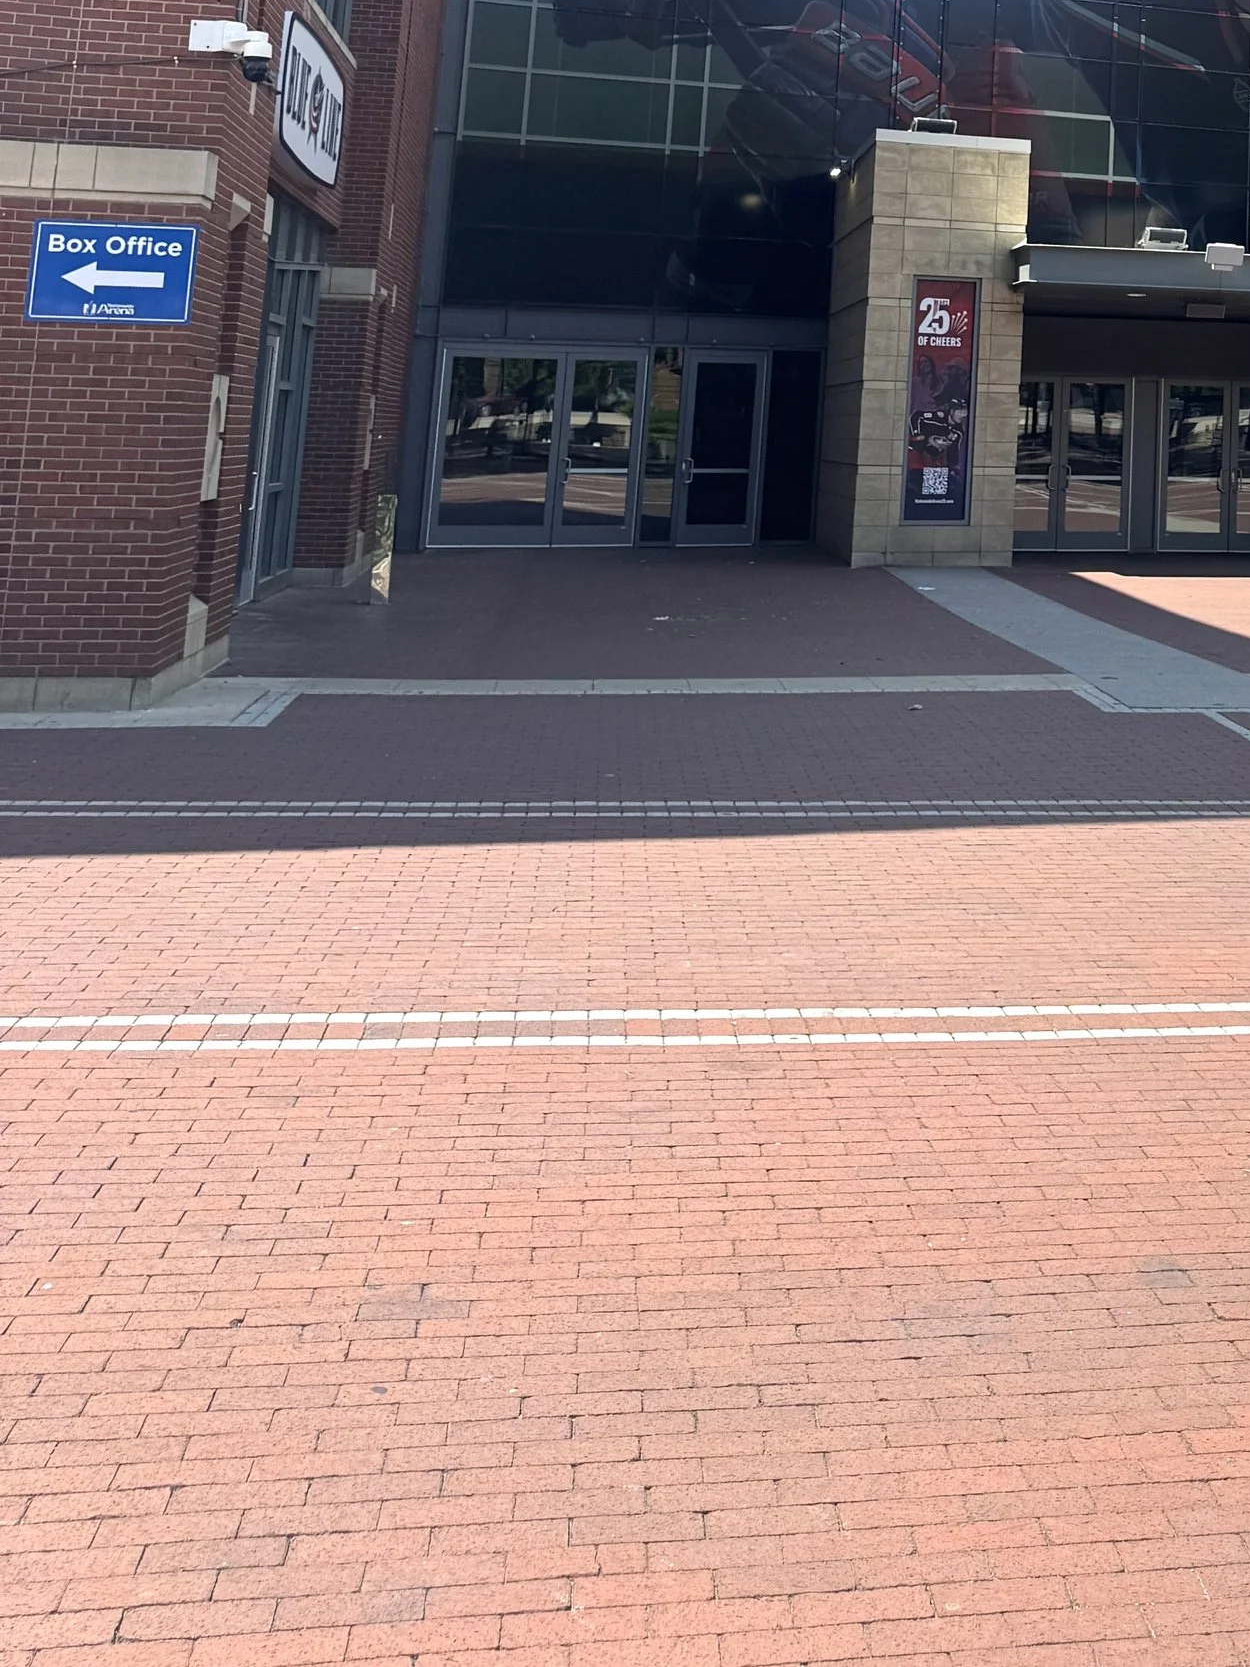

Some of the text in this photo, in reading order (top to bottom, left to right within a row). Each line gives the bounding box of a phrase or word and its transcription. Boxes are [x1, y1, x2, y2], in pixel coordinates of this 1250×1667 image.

[48, 233, 183, 257] Box Office
[97, 303, 135, 315] Arena
[918, 297, 951, 335] 25
[918, 335, 962, 347] OF CHEERS
